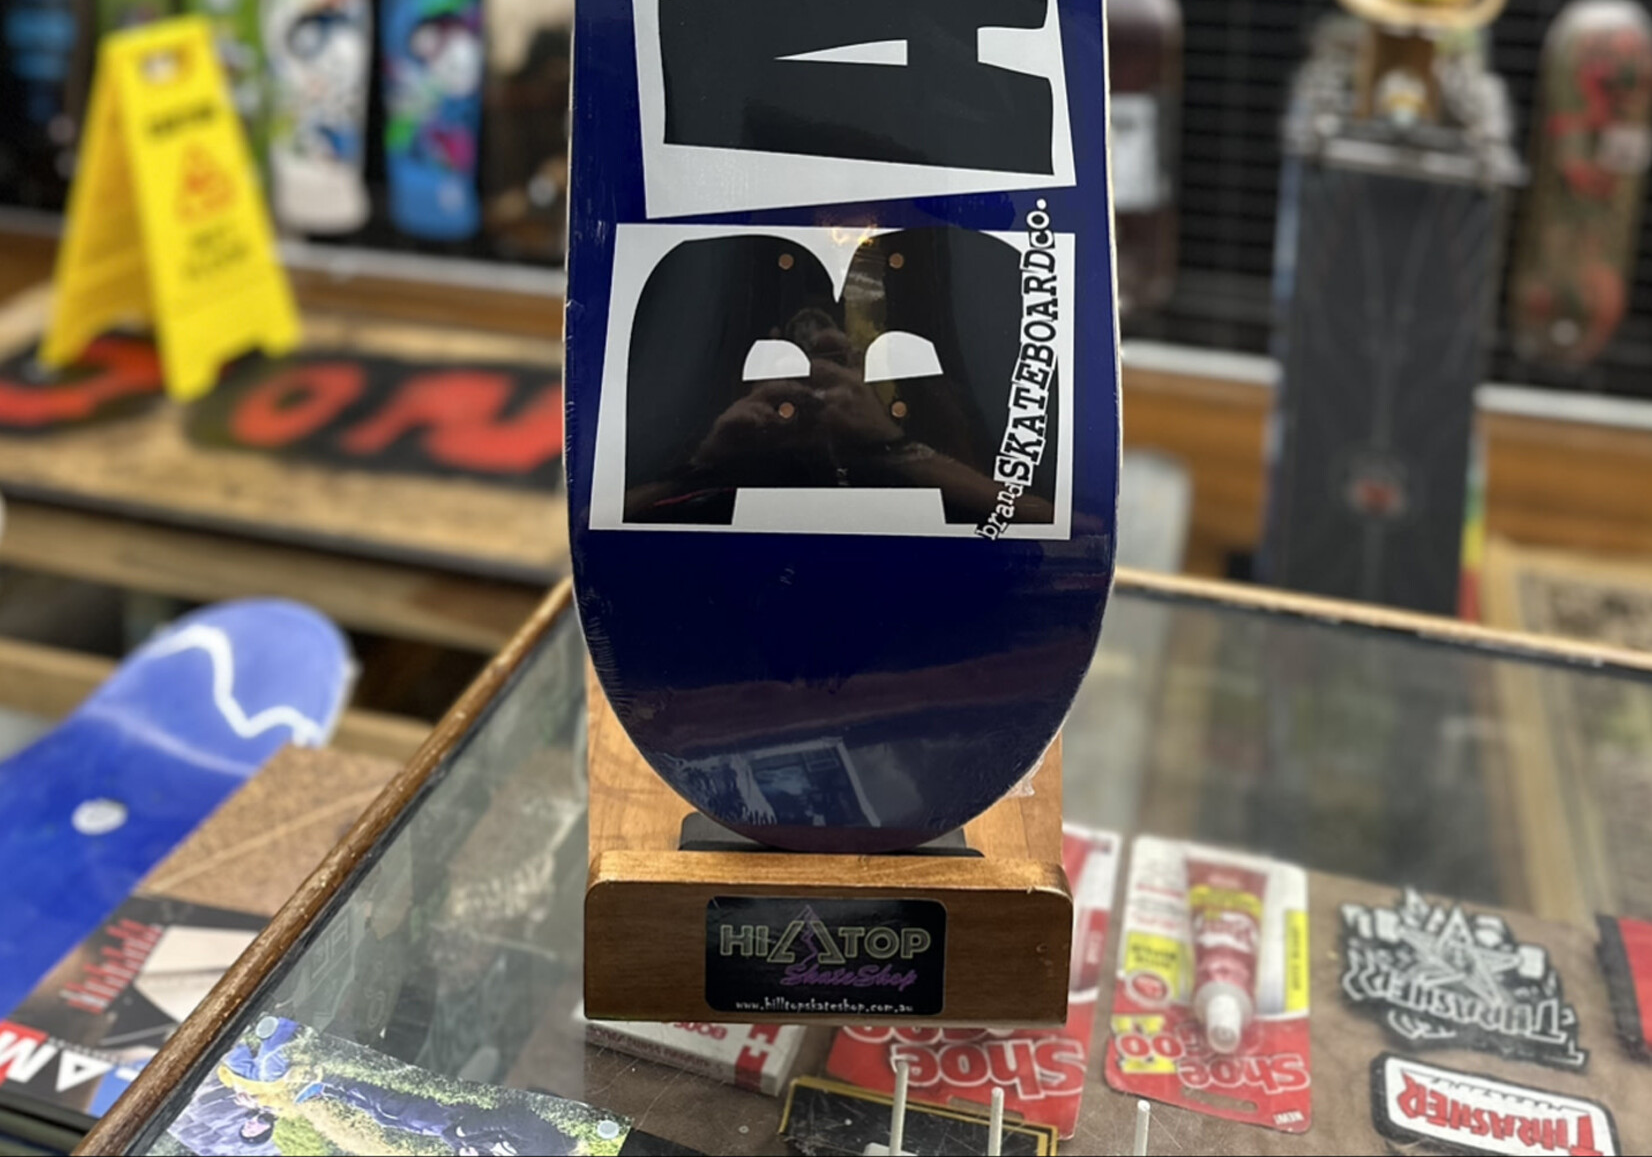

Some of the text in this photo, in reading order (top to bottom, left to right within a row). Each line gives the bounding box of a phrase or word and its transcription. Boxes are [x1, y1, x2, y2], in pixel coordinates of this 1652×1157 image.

[997, 249, 1059, 482] SKATEBOARD
[975, 481, 1024, 541] brand
[735, 996, 914, 1014] www.hilltopskateshop.com.au
[889, 1037, 1088, 1100] Shoe
[1176, 1052, 1311, 1095] Shoe
[1397, 1072, 1605, 1156] THRASHER
